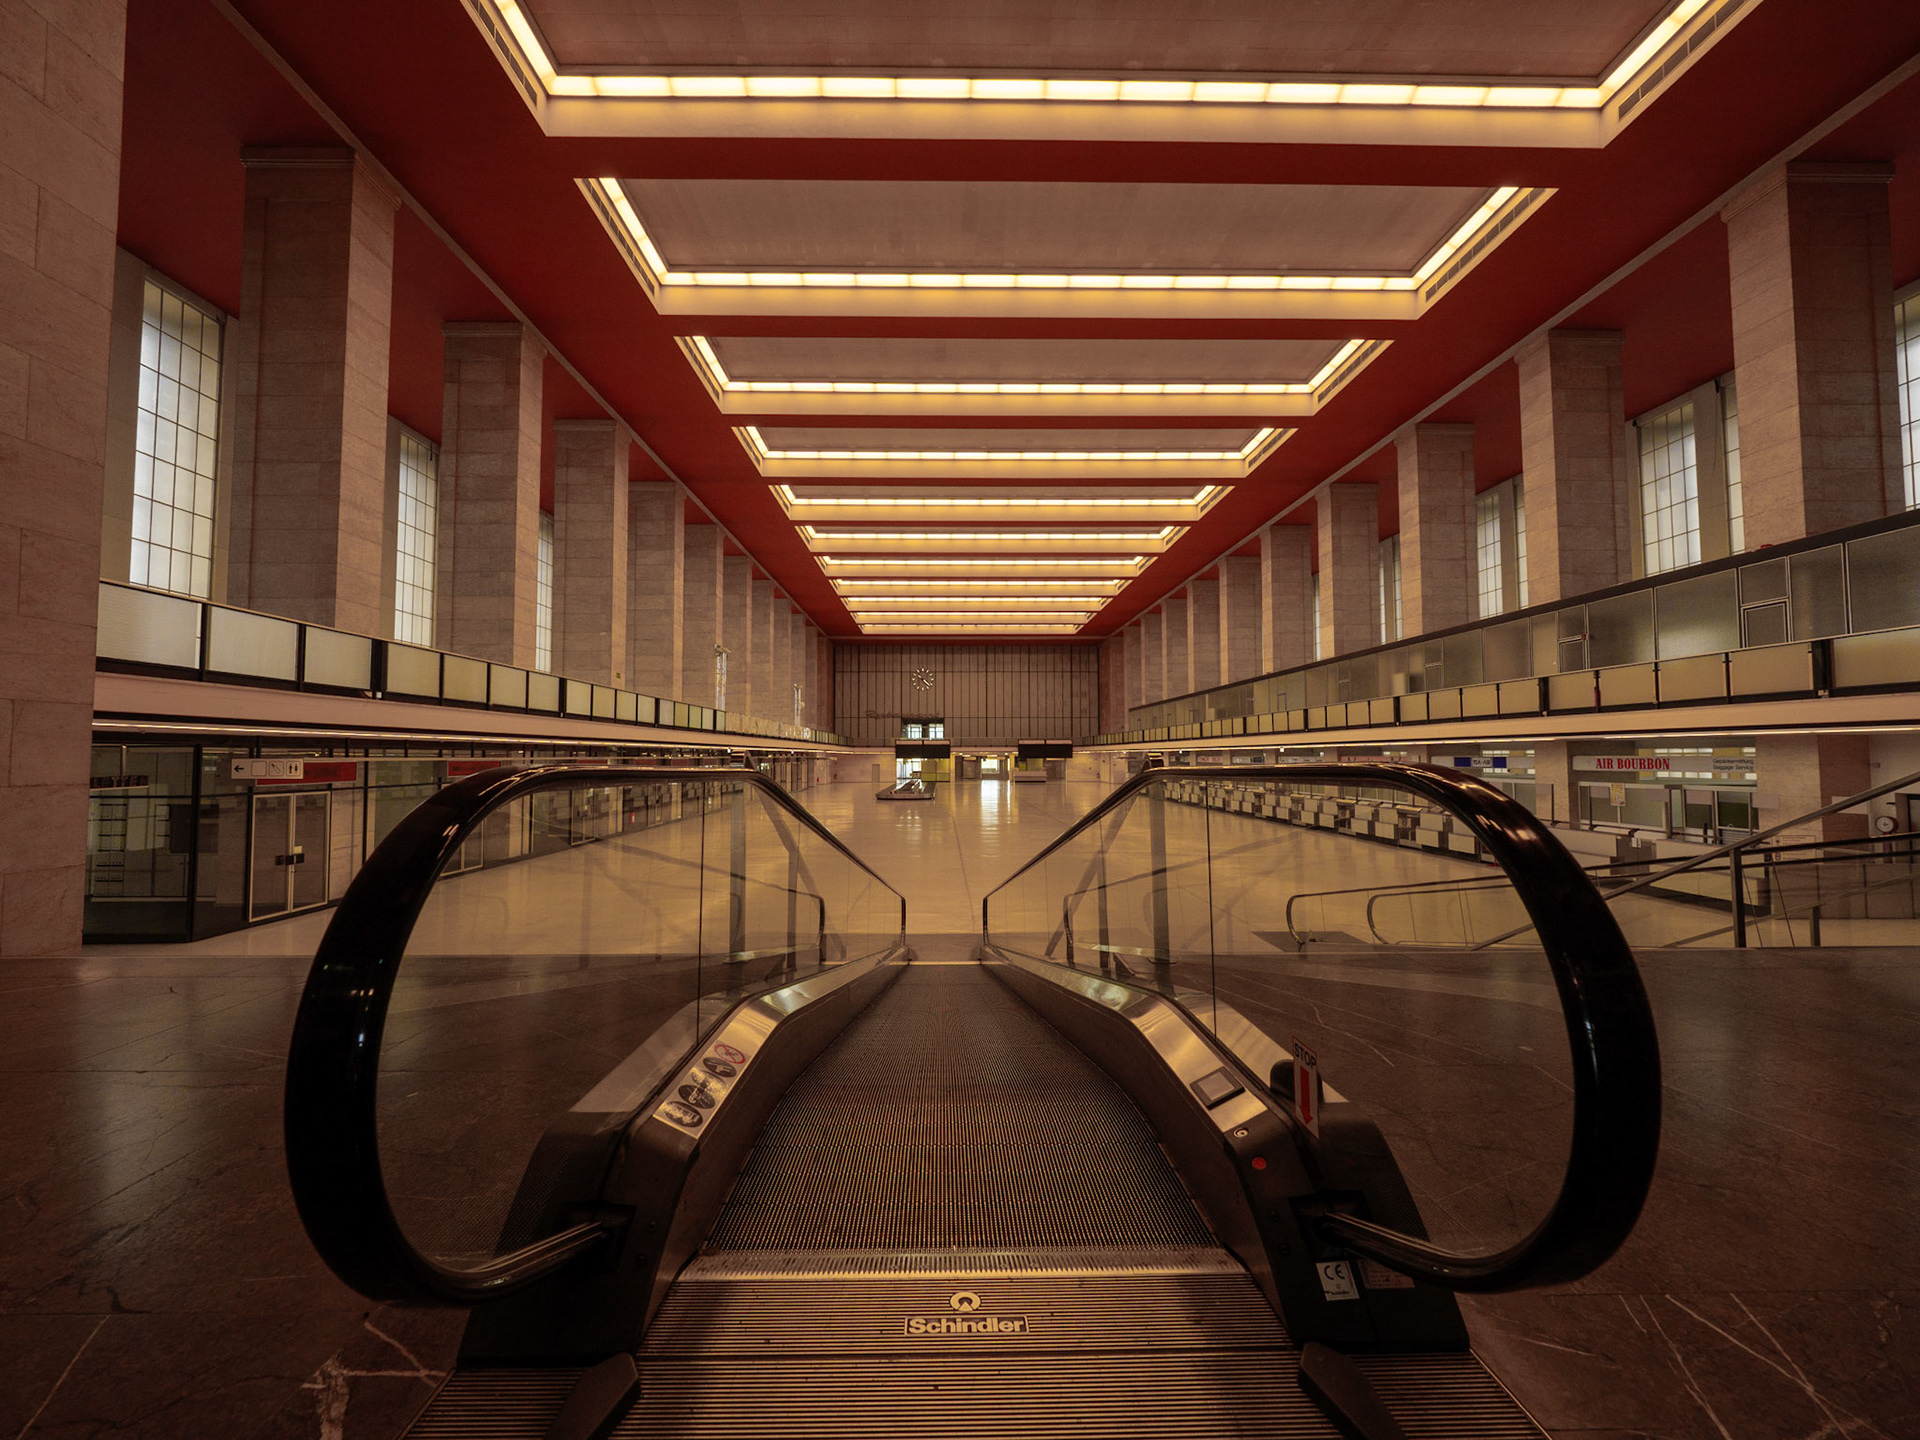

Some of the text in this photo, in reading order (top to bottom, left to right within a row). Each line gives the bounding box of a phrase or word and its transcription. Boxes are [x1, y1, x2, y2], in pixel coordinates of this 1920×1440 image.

[1596, 758, 1670, 770] AIR BOURBON
[1295, 1043, 1317, 1069] STOP
[1324, 1264, 1345, 1280] CE
[909, 1317, 1024, 1334] Schindler
